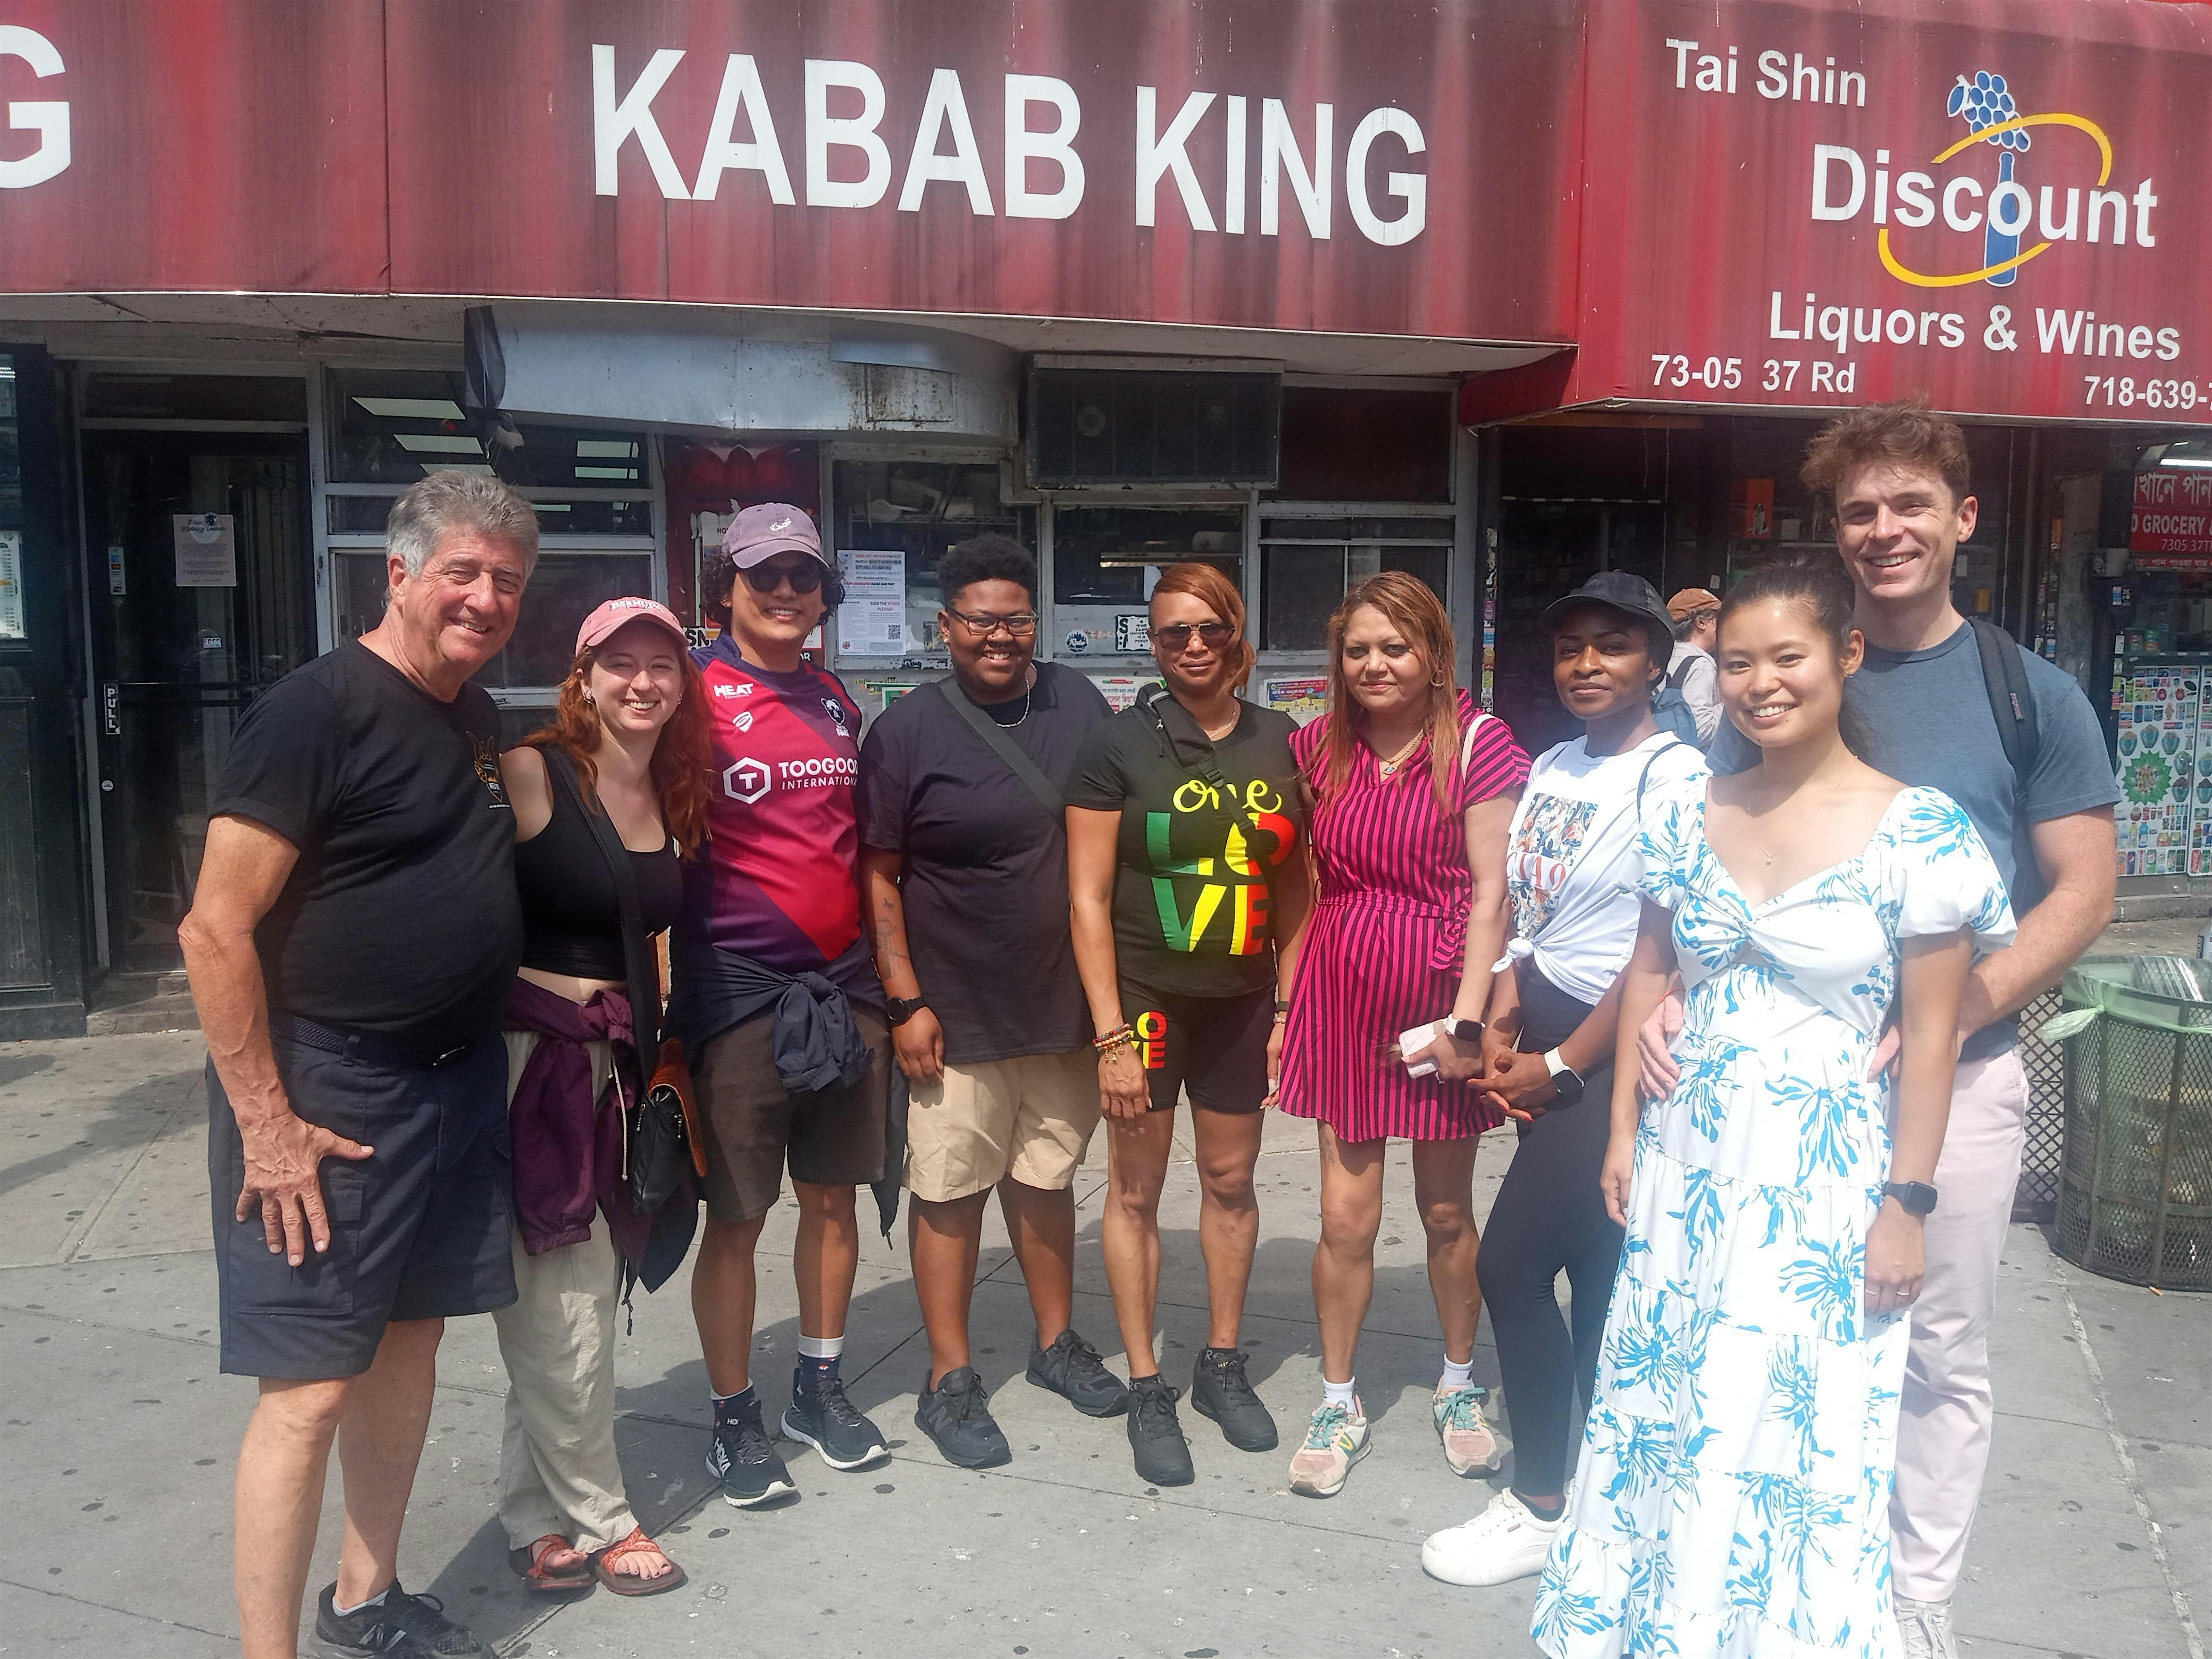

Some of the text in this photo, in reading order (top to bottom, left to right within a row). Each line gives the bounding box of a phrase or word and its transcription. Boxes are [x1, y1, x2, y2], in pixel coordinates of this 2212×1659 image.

[1666, 38, 1866, 107] Tai Shin
[592, 44, 1427, 246] KABAB KING
[1811, 144, 2158, 248] Discount
[1770, 291, 2181, 361] Liquors & Wines
[1652, 355, 1856, 393] 73-05 37 Rd
[2134, 471, 2178, 504] খানে
[2142, 514, 2206, 535] GROCERY
[2160, 539, 2187, 551] 7305
[107, 688, 116, 728] PULL
[713, 683, 754, 697] HEAT
